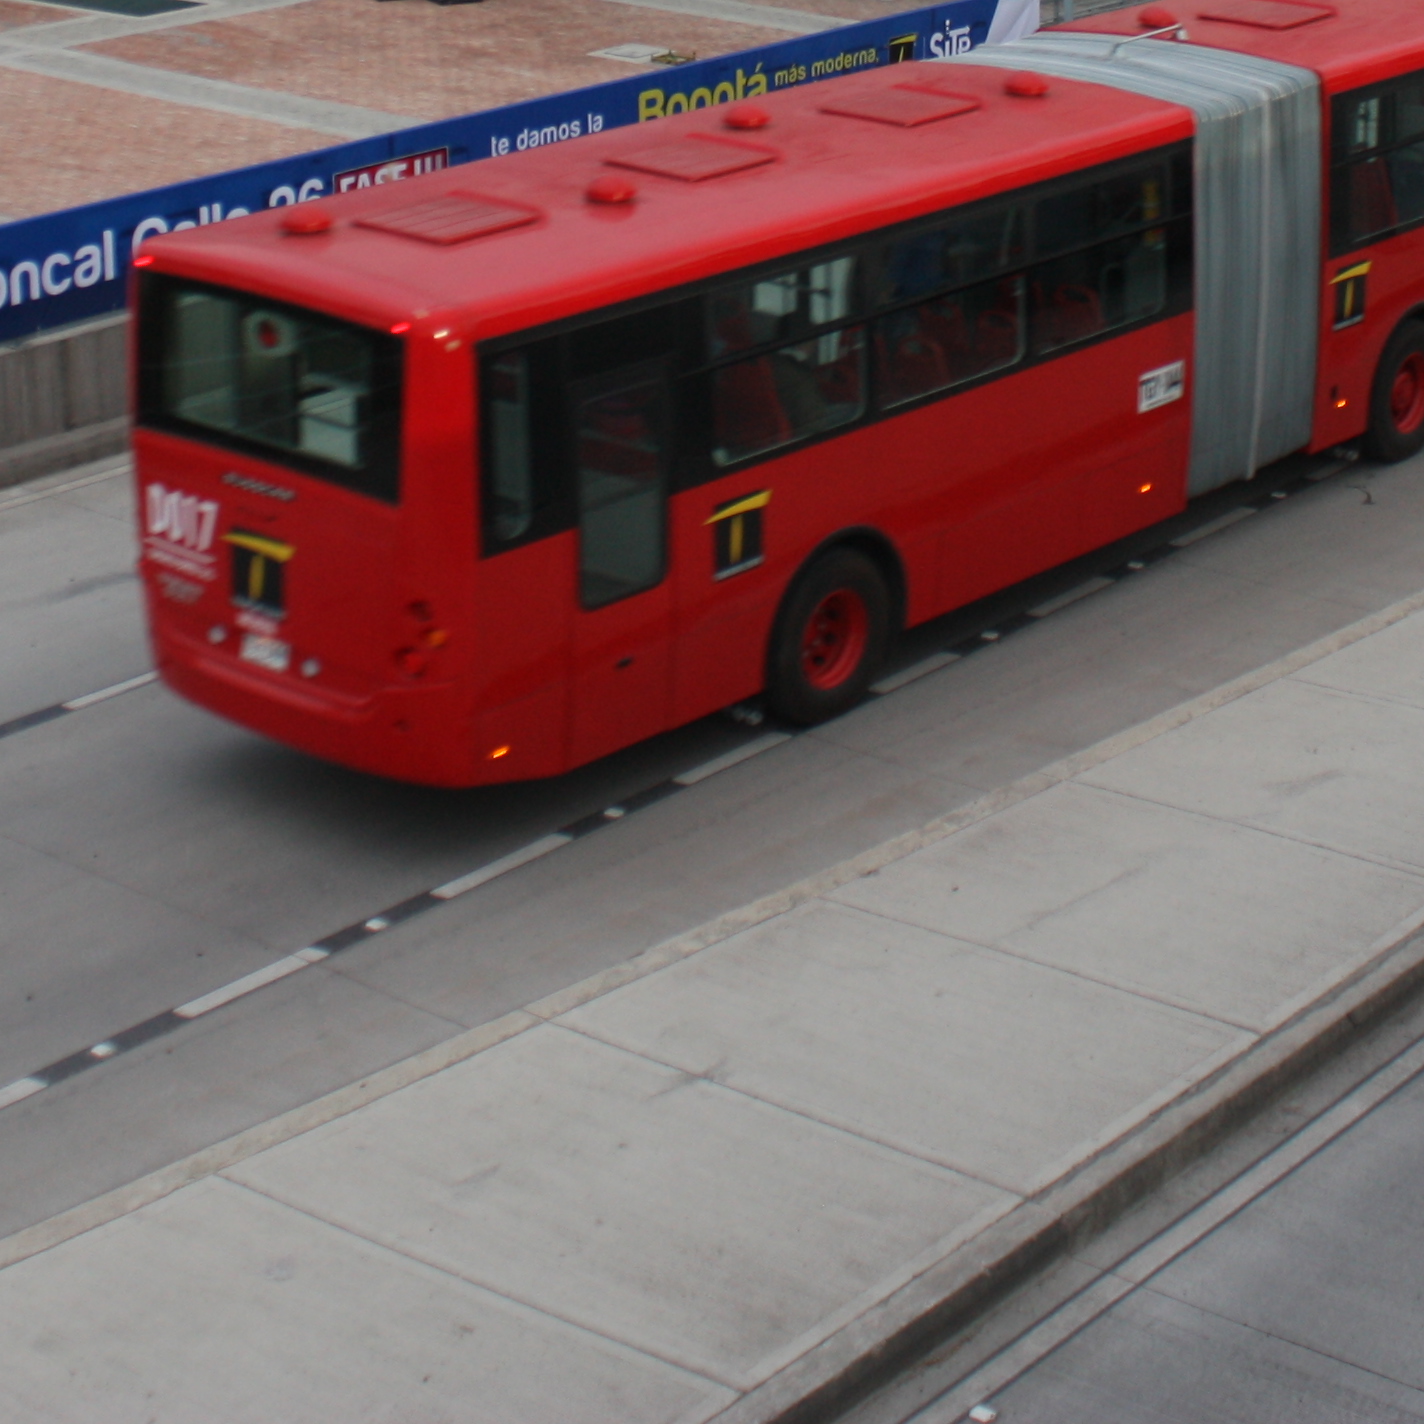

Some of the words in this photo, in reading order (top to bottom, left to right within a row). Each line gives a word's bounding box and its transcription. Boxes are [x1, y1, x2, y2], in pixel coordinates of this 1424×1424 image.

[775, 63, 806, 86] más
[491, 136, 510, 157] te
[516, 121, 581, 152] damos
[587, 113, 603, 134] la
